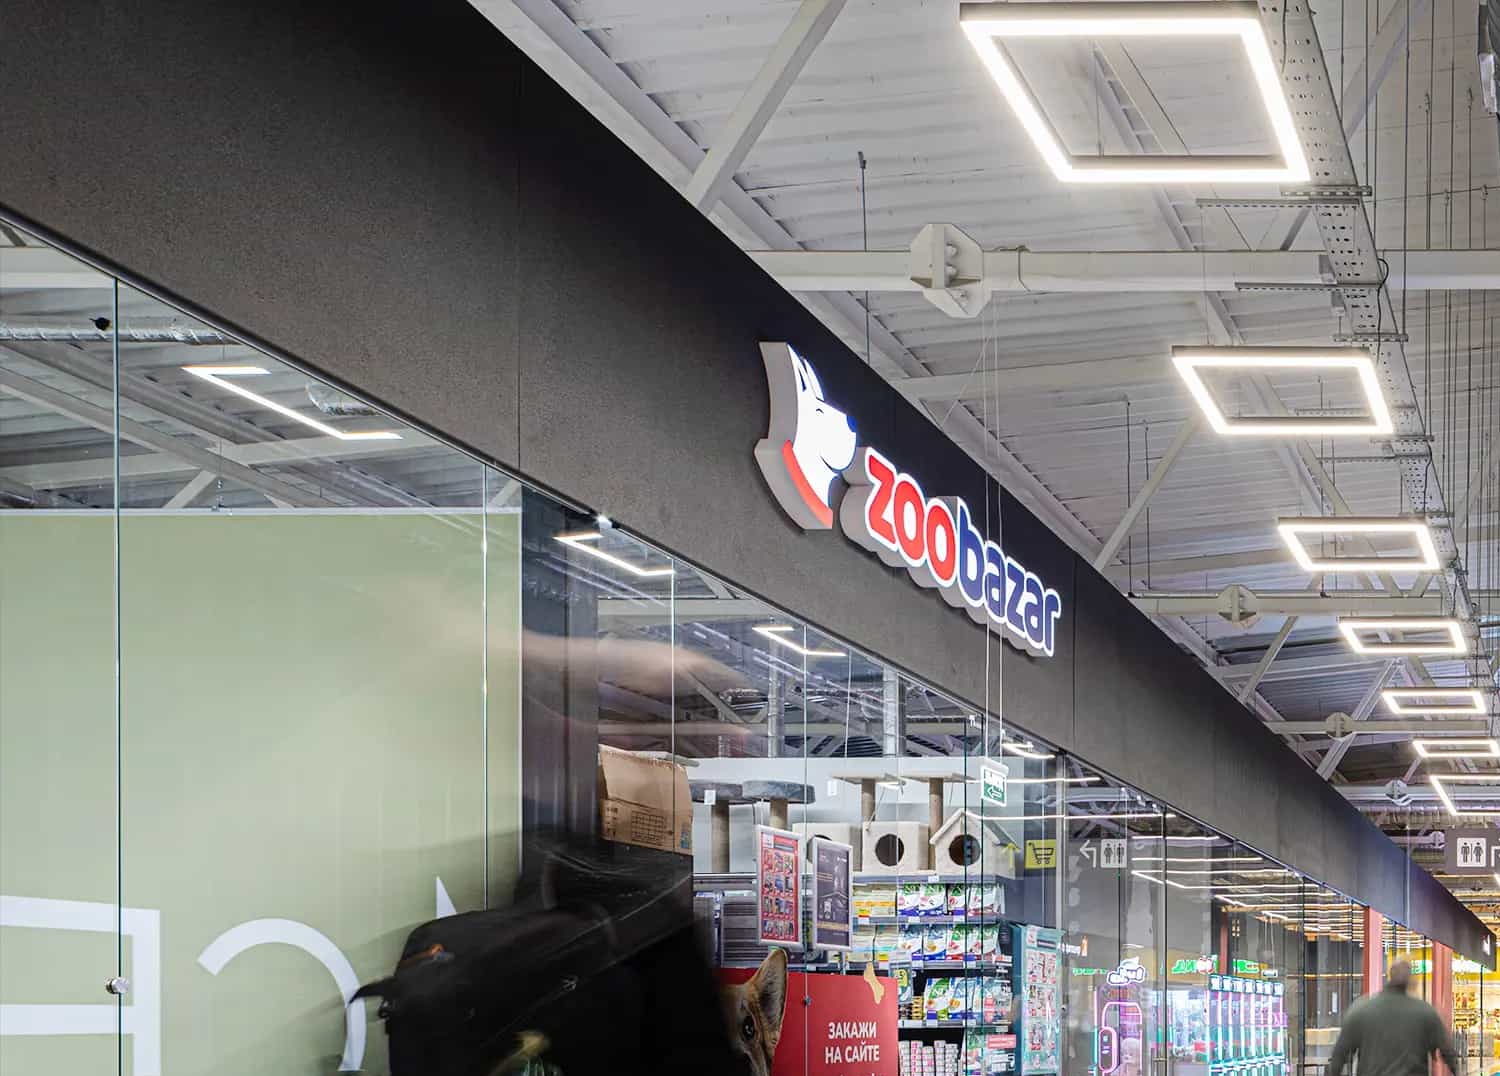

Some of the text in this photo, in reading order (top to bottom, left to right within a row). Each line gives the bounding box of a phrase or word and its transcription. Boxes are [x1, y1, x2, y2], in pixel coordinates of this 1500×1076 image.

[864, 446, 1062, 657] zoobazar
[828, 1021, 877, 1040] ЗАКАЖИ
[825, 1041, 880, 1064] НА САЙТЕ
